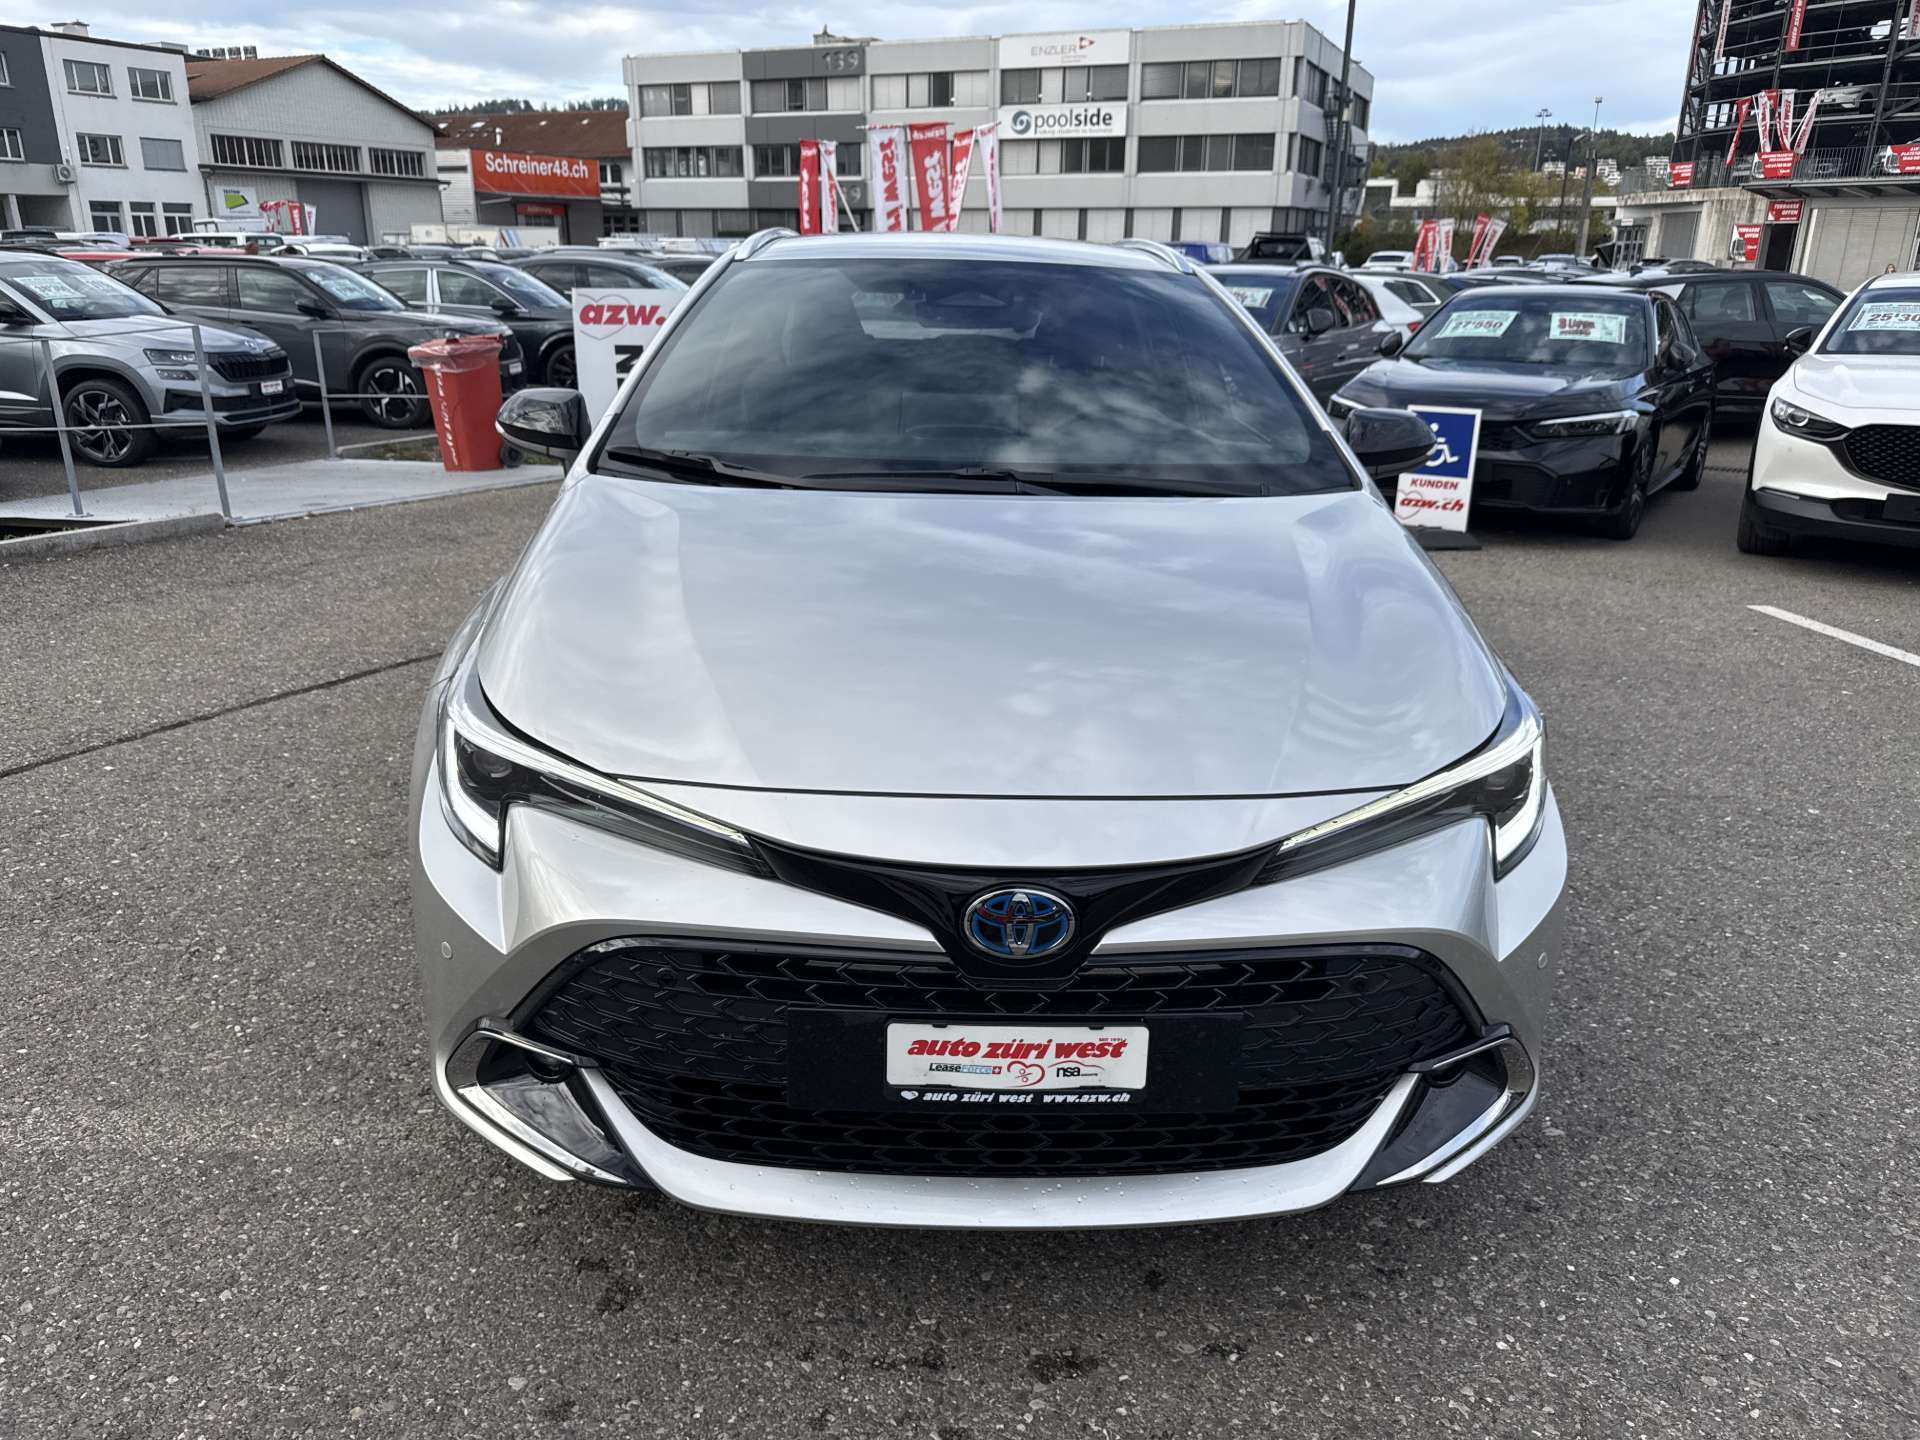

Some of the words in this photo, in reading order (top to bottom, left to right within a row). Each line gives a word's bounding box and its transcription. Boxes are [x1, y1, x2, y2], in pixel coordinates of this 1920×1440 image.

[1030, 45, 1078, 57] ENZLER
[822, 51, 859, 71] 139
[1034, 107, 1113, 135] poolside
[484, 152, 589, 178] Schreiner48.ch
[579, 303, 668, 326] azw.
[1868, 313, 1920, 321] 25'30
[1410, 478, 1459, 490] KUNDEN
[1400, 497, 1465, 512] azw.ch
[908, 1037, 981, 1056] auto
[981, 1038, 1053, 1059] züri
[1055, 1040, 1128, 1059] west
[1056, 1066, 1081, 1078] nsa
[923, 1091, 958, 1101] auto
[960, 1091, 993, 1102] züri
[998, 1092, 1034, 1103] west
[1042, 1092, 1131, 1103] www.azw.ch
